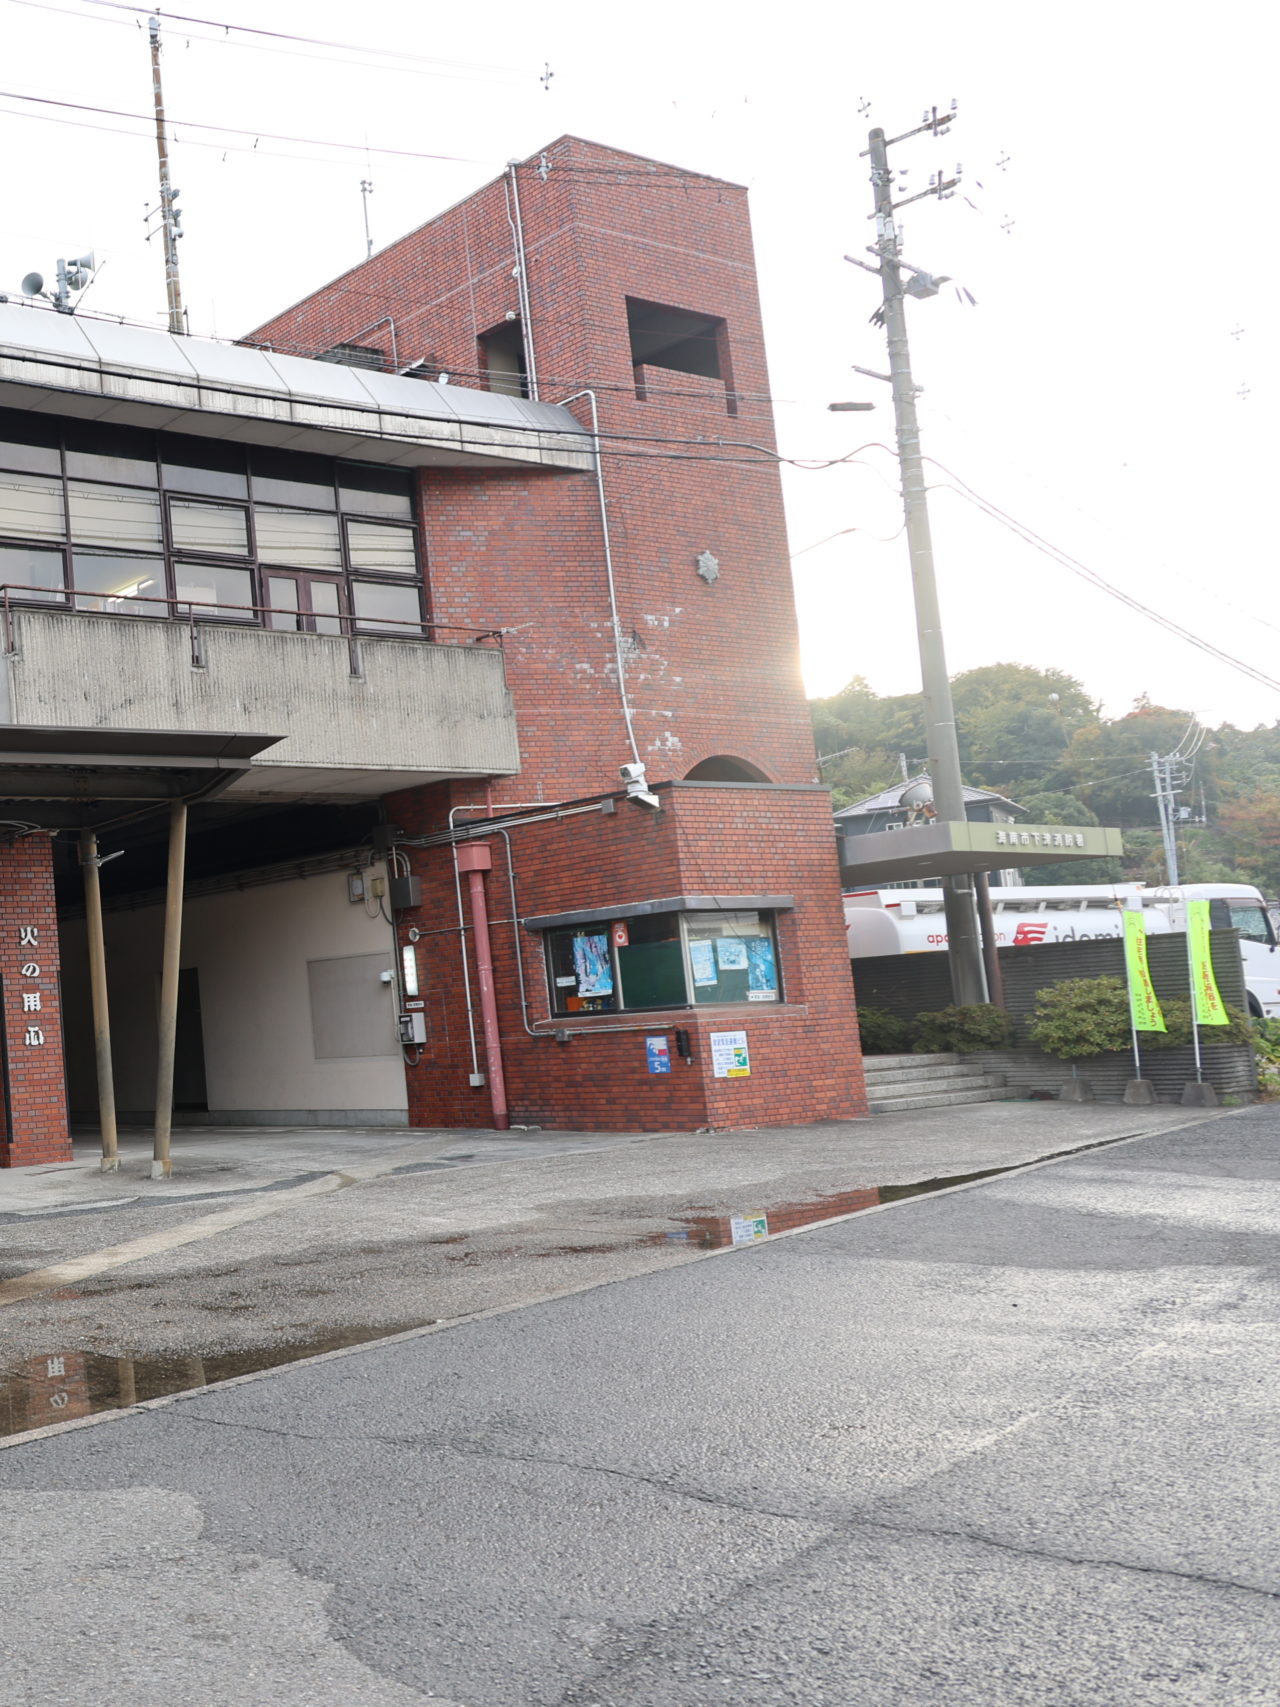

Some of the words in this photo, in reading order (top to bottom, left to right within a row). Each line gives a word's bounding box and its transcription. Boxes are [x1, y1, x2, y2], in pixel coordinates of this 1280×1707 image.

[1053, 924, 1121, 943] idemi
[19, 926, 45, 1046] 火の用心
